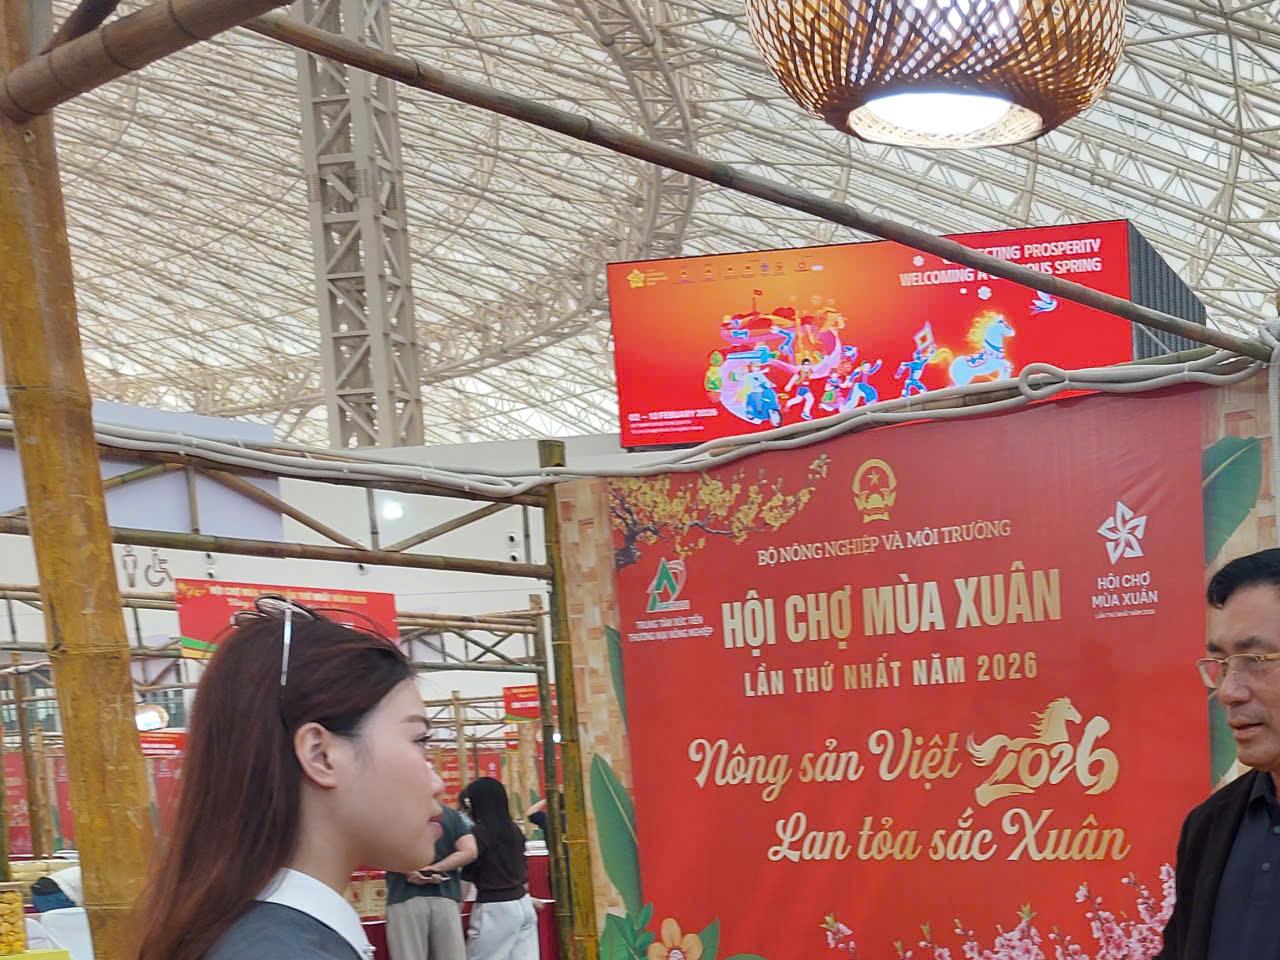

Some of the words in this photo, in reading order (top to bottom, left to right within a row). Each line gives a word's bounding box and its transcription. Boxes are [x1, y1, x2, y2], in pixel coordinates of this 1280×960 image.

[899, 268, 975, 287] WELCOMING
[1054, 257, 1102, 275] SPRING
[1023, 238, 1102, 259] PROSPERITY
[757, 545, 778, 568] BỘ
[779, 542, 823, 563] NÔNG
[824, 533, 880, 557] NGHIỆP
[882, 527, 905, 551] VÀ
[906, 524, 940, 548] MÔI
[943, 518, 1012, 545] TRƯỜNG
[1091, 591, 1121, 609] MÙA
[1121, 588, 1159, 606] XUÂN
[1096, 572, 1121, 591] HỘI
[1121, 570, 1151, 588] CHỢ
[720, 588, 776, 658] HỘI
[784, 584, 853, 650] CHỢ
[861, 573, 946, 637] MÙA
[953, 560, 1062, 630] XUÂN
[743, 662, 785, 698] LẦN
[793, 659, 836, 694] THỨ
[842, 652, 902, 691] NHẤT
[912, 653, 967, 687] NĂM
[975, 650, 1039, 682] 2026
[687, 738, 793, 803] Nông
[799, 738, 865, 783] sản
[867, 727, 964, 791] Việt
[767, 811, 852, 863] Lan
[856, 815, 922, 862] tỏa
[928, 806, 998, 862] sắc
[1001, 806, 1131, 863] Xuân
